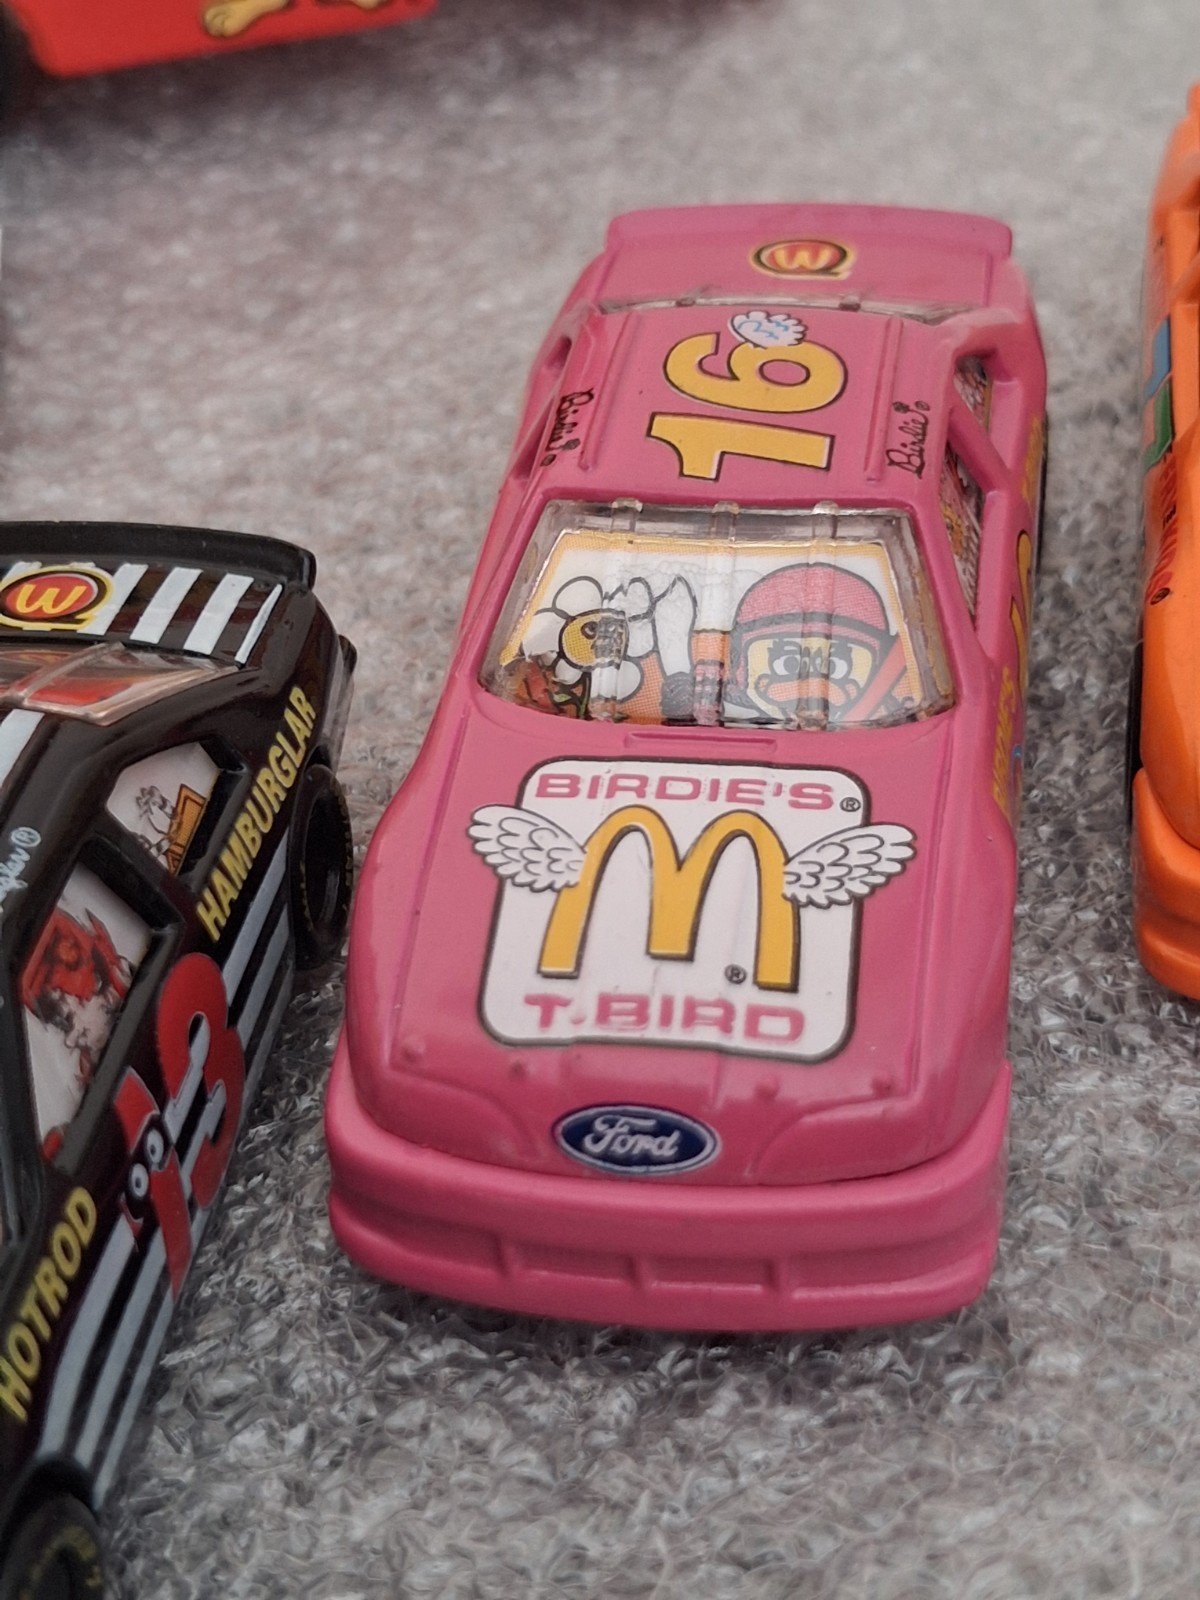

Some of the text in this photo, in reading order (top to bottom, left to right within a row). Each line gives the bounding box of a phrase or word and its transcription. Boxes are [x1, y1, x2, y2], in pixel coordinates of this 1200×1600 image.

[647, 332, 847, 480] 16
[197, 686, 317, 940] HAMBURGLAR
[525, 994, 804, 1043] T.BIRD
[584, 1114, 680, 1157] Ford
[0, 1187, 97, 1420] HOTROD
